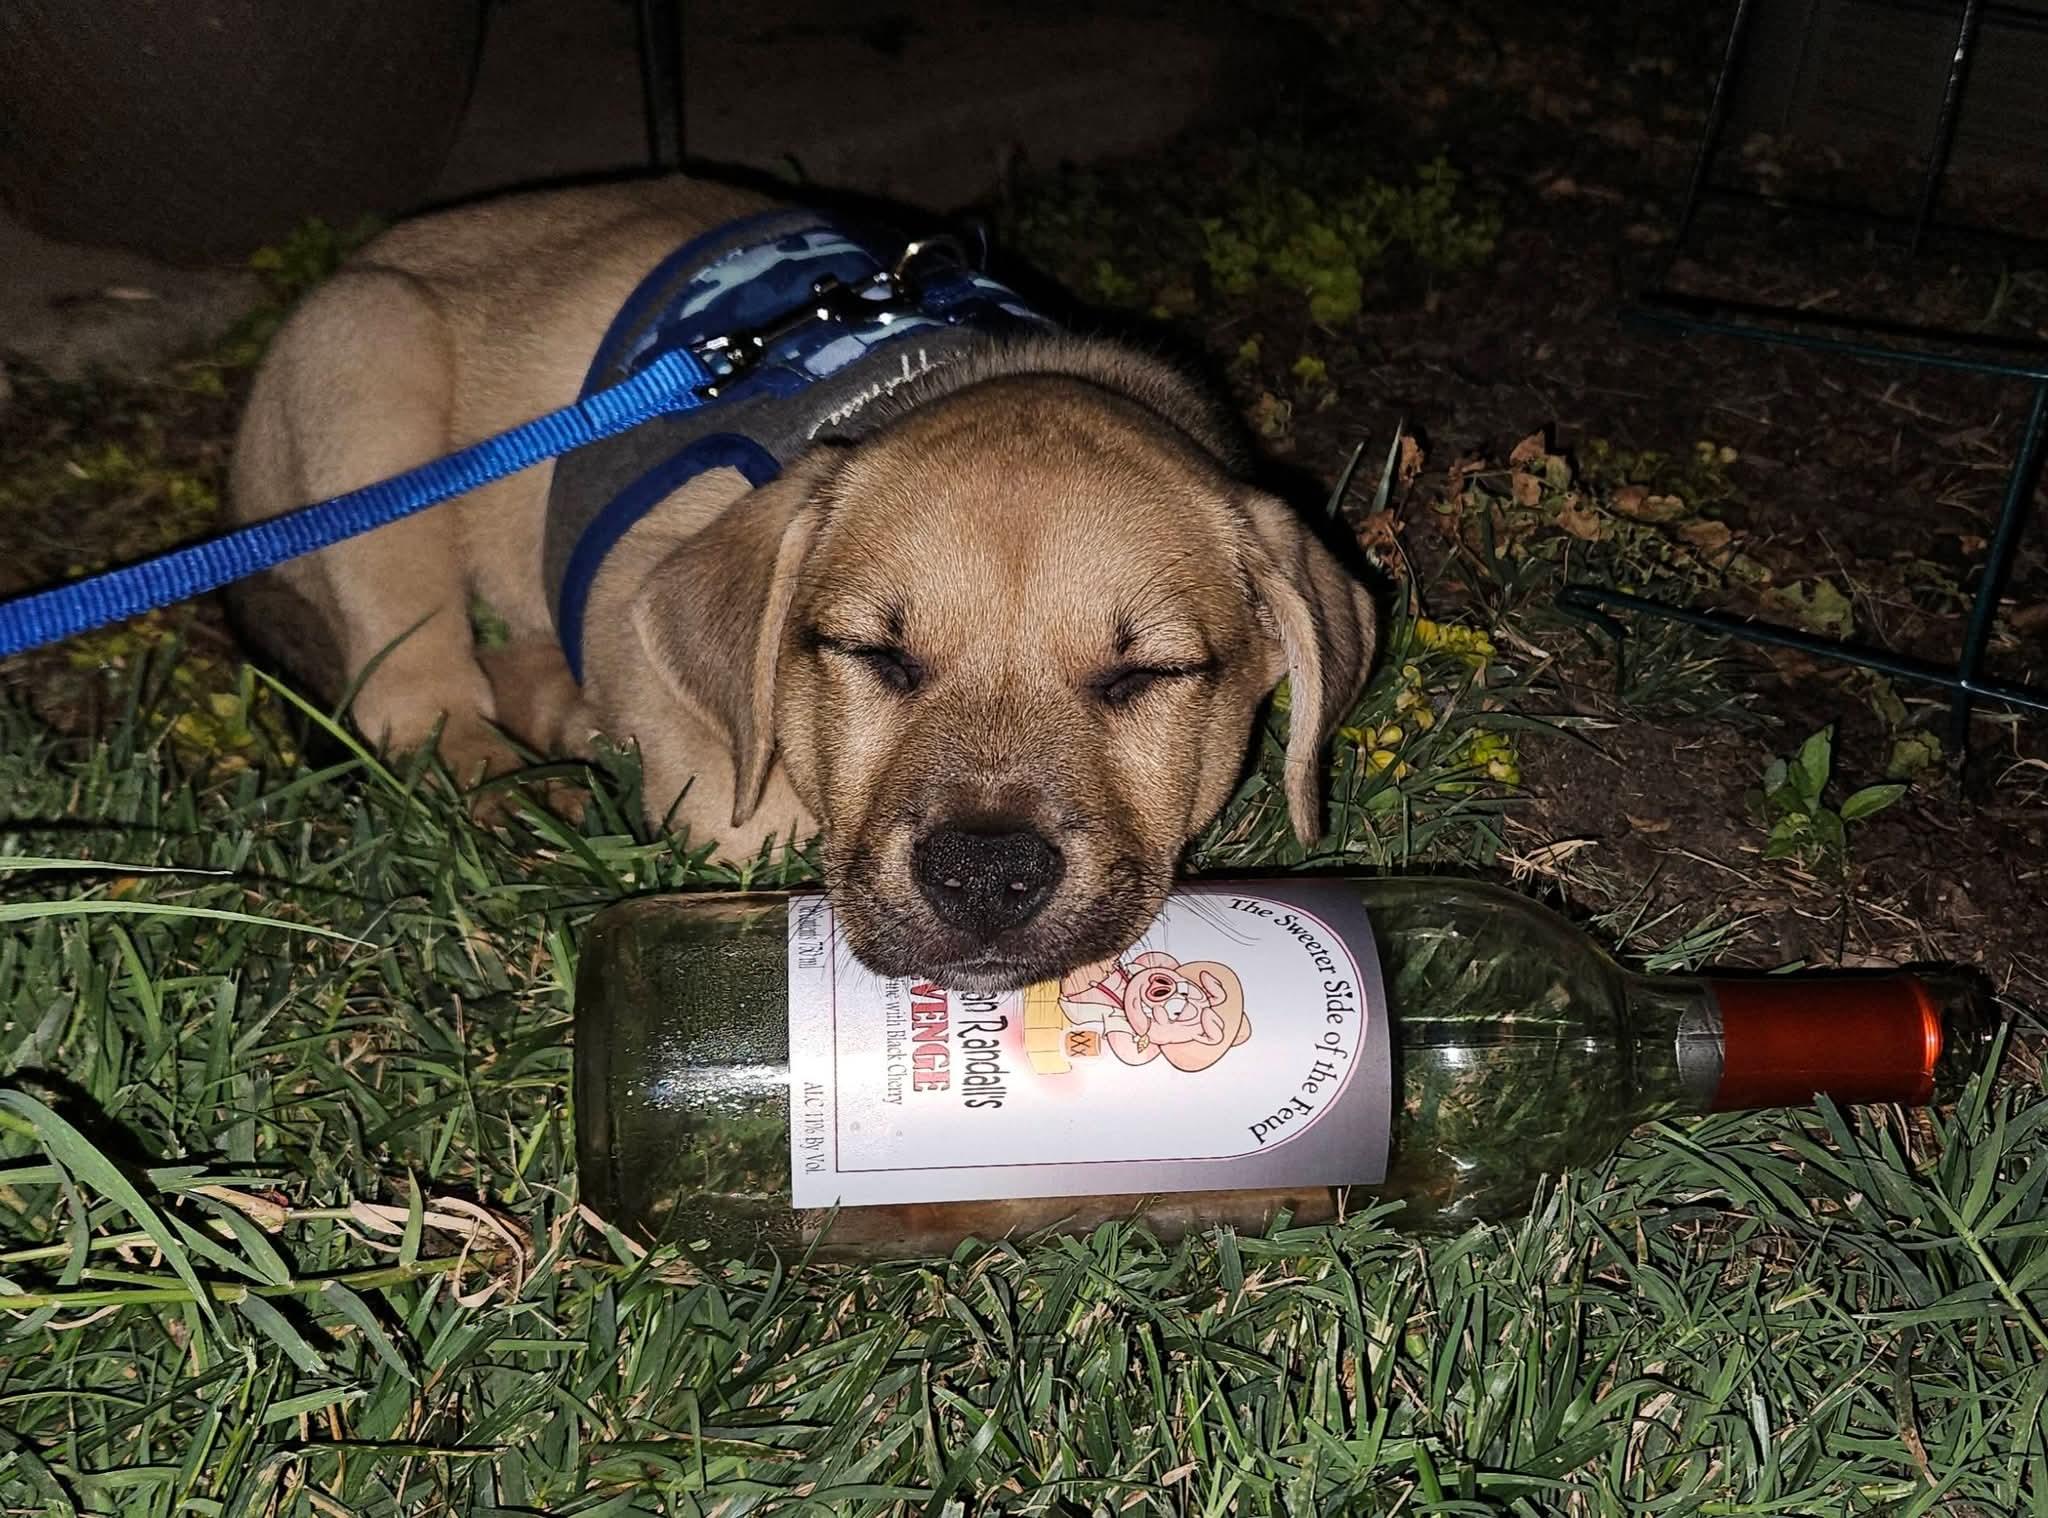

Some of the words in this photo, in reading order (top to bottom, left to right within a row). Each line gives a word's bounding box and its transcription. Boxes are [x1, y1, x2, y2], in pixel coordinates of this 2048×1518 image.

[1228, 898, 1274, 918] The
[1274, 914, 1336, 974] Sweeter
[886, 1001, 907, 1027] with
[1323, 980, 1356, 1024] Side
[887, 1030, 908, 1060] Black
[911, 975, 950, 1092] VENGE
[1314, 1031, 1348, 1059] of
[957, 1015, 1010, 1108] Randall's
[1301, 1060, 1338, 1094] the
[882, 1064, 908, 1105] Cherry
[1248, 1096, 1314, 1144] Feud
[800, 1137, 825, 1150] By
